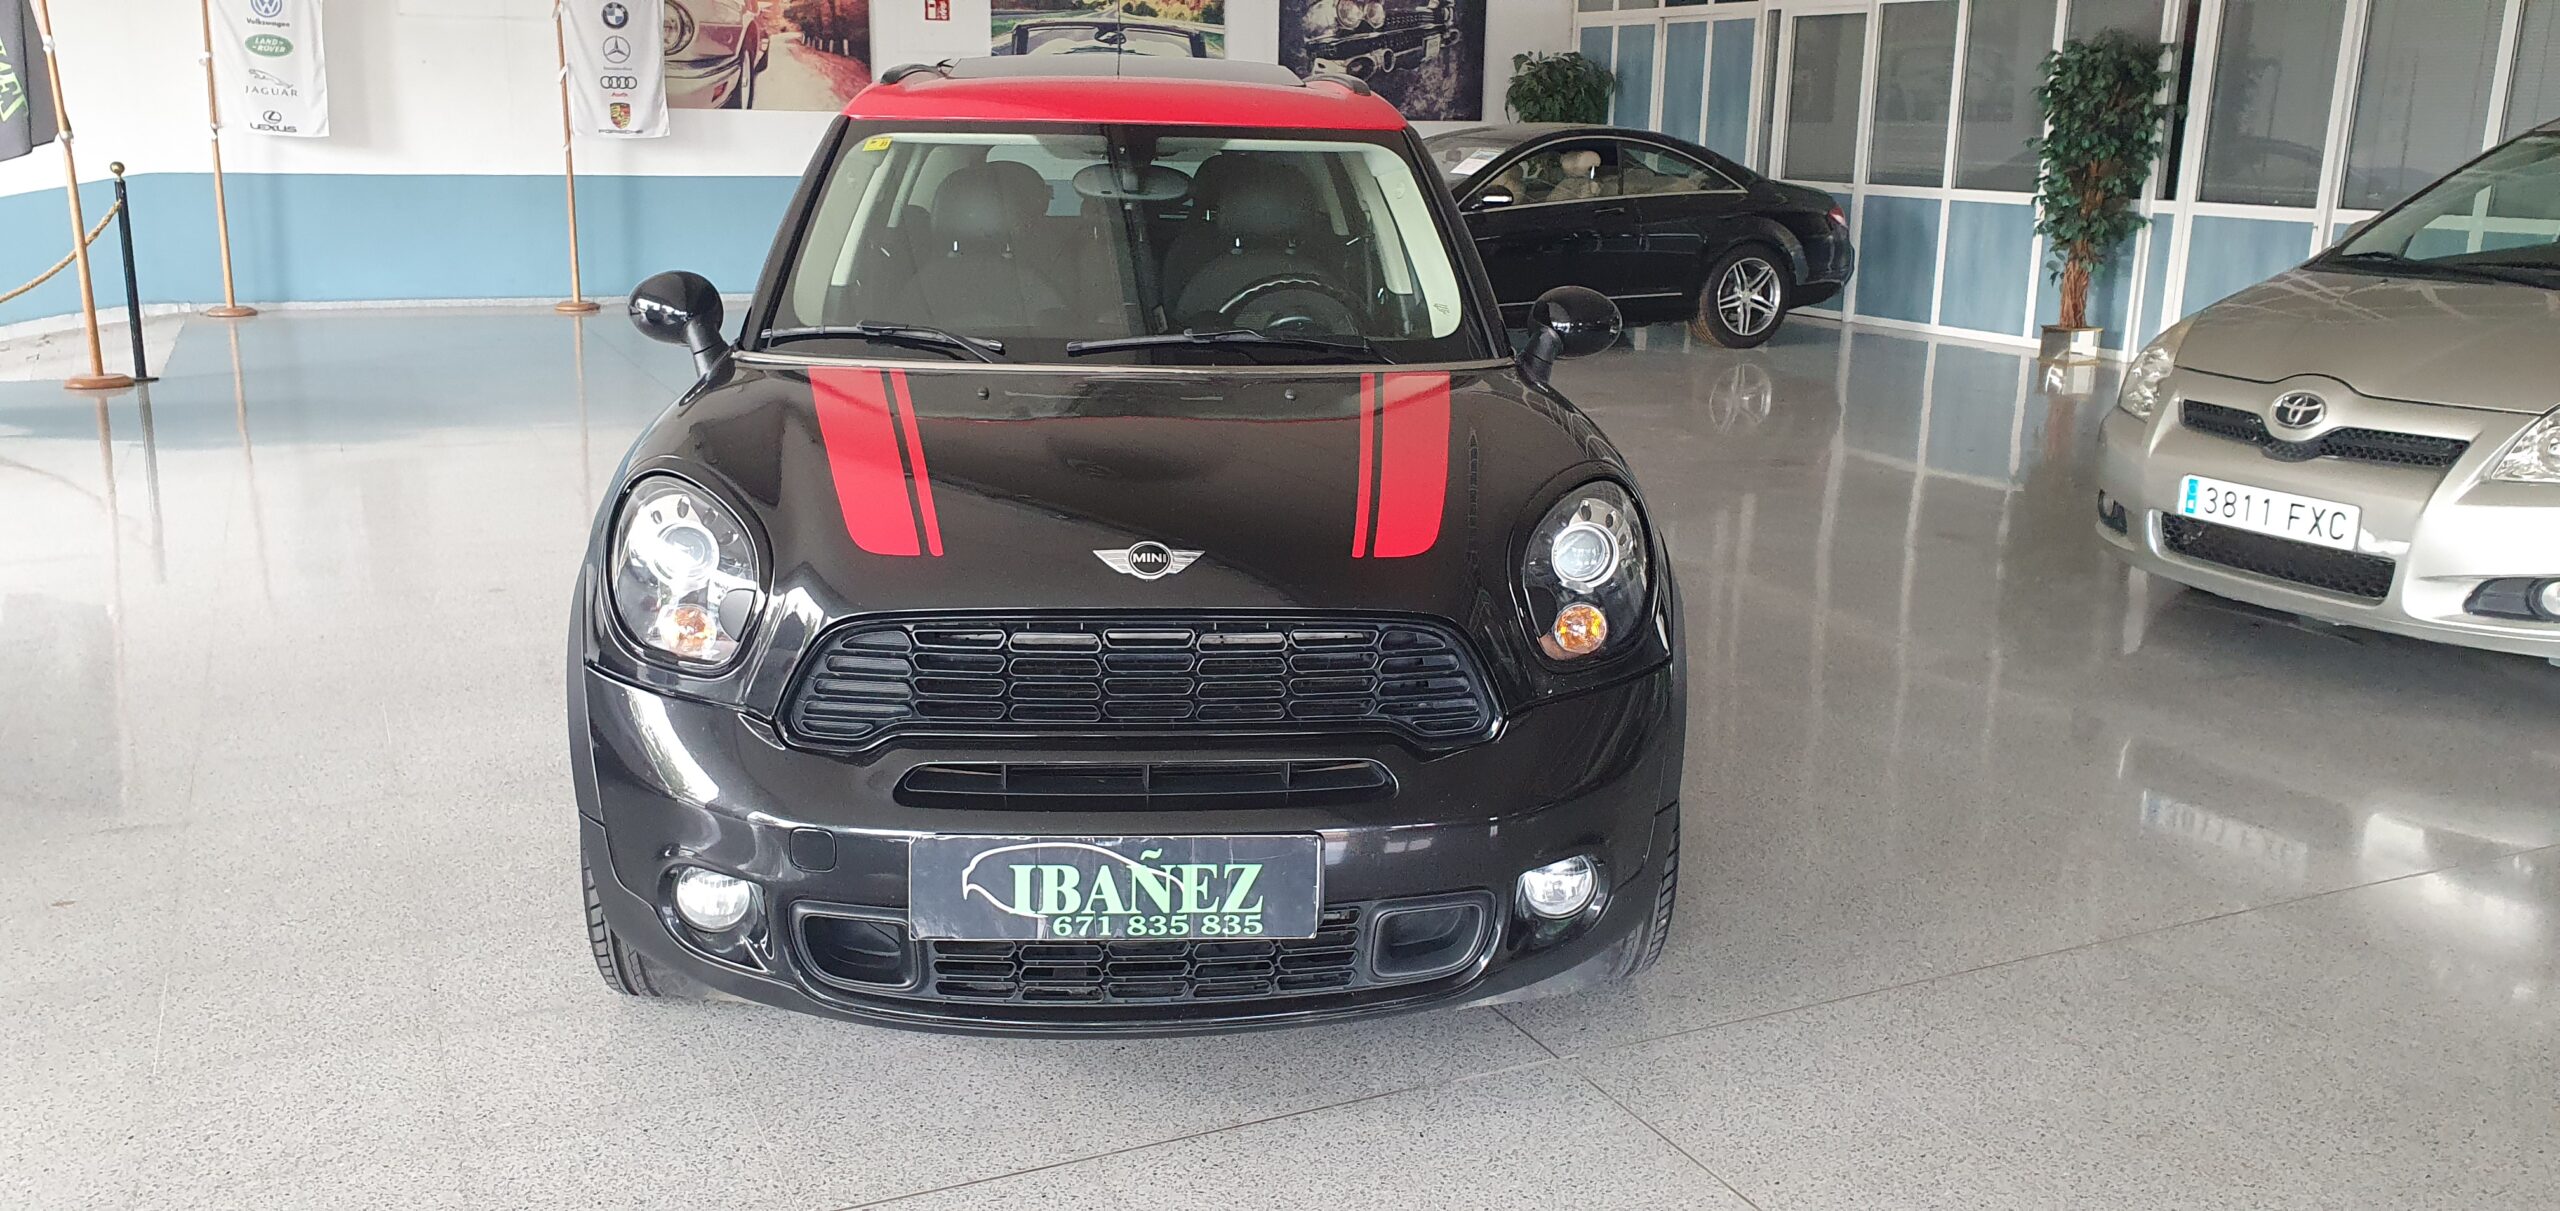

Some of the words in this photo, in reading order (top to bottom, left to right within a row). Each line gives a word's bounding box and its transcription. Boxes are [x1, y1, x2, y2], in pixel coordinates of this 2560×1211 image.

[245, 85, 298, 97] JAGUAR
[249, 122, 297, 133] LEXUS
[2204, 487, 2270, 526] 3811
[2287, 503, 2347, 540] FXC
[1132, 552, 1168, 564] MINI
[1008, 848, 1264, 915] IBAÑEZ
[1052, 915, 1112, 937] 671
[1126, 914, 1190, 936] 835
[1200, 913, 1264, 935] 835
